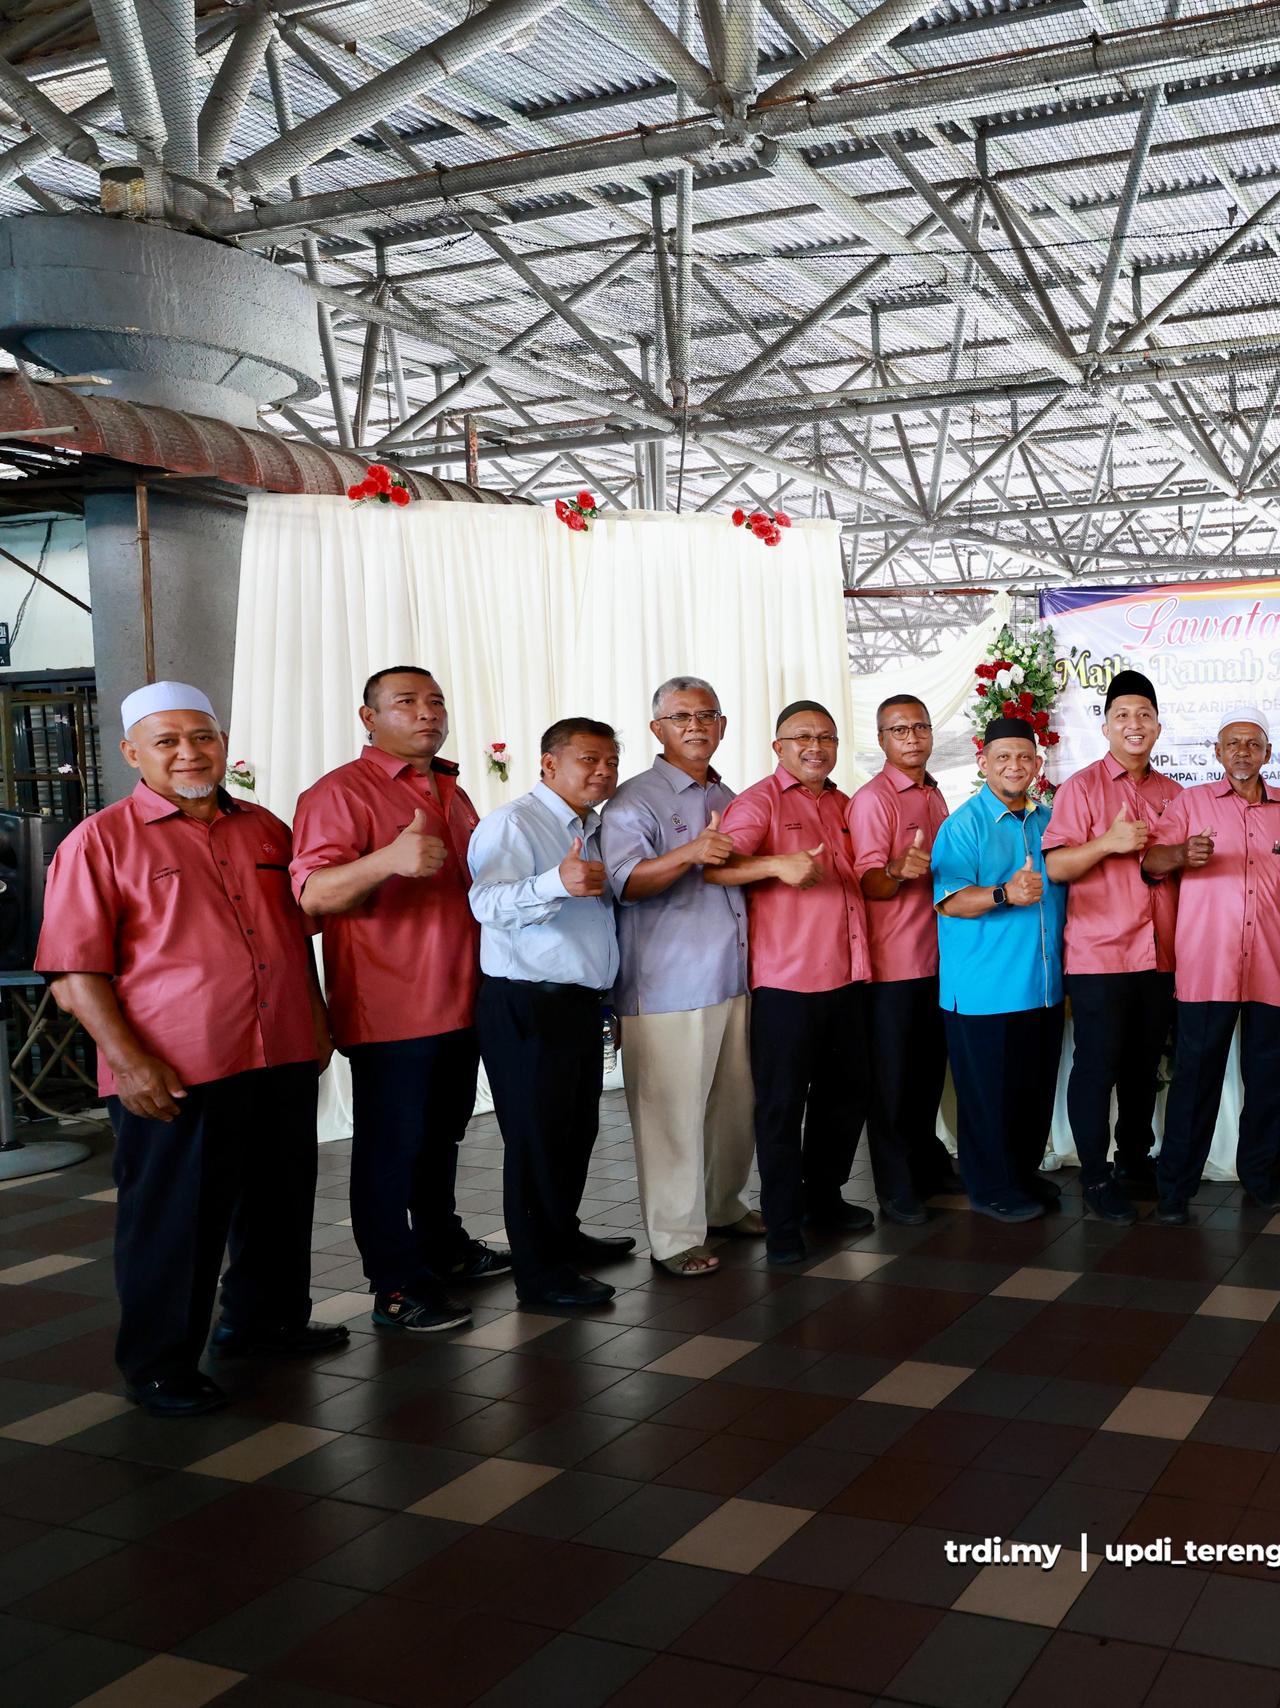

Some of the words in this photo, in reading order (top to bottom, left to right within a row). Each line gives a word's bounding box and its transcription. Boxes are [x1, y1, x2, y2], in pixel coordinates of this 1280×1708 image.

[1149, 648, 1265, 690] Ramah
[1160, 702, 1196, 714] STAZ
[1149, 753, 1208, 767] MPLEKS
